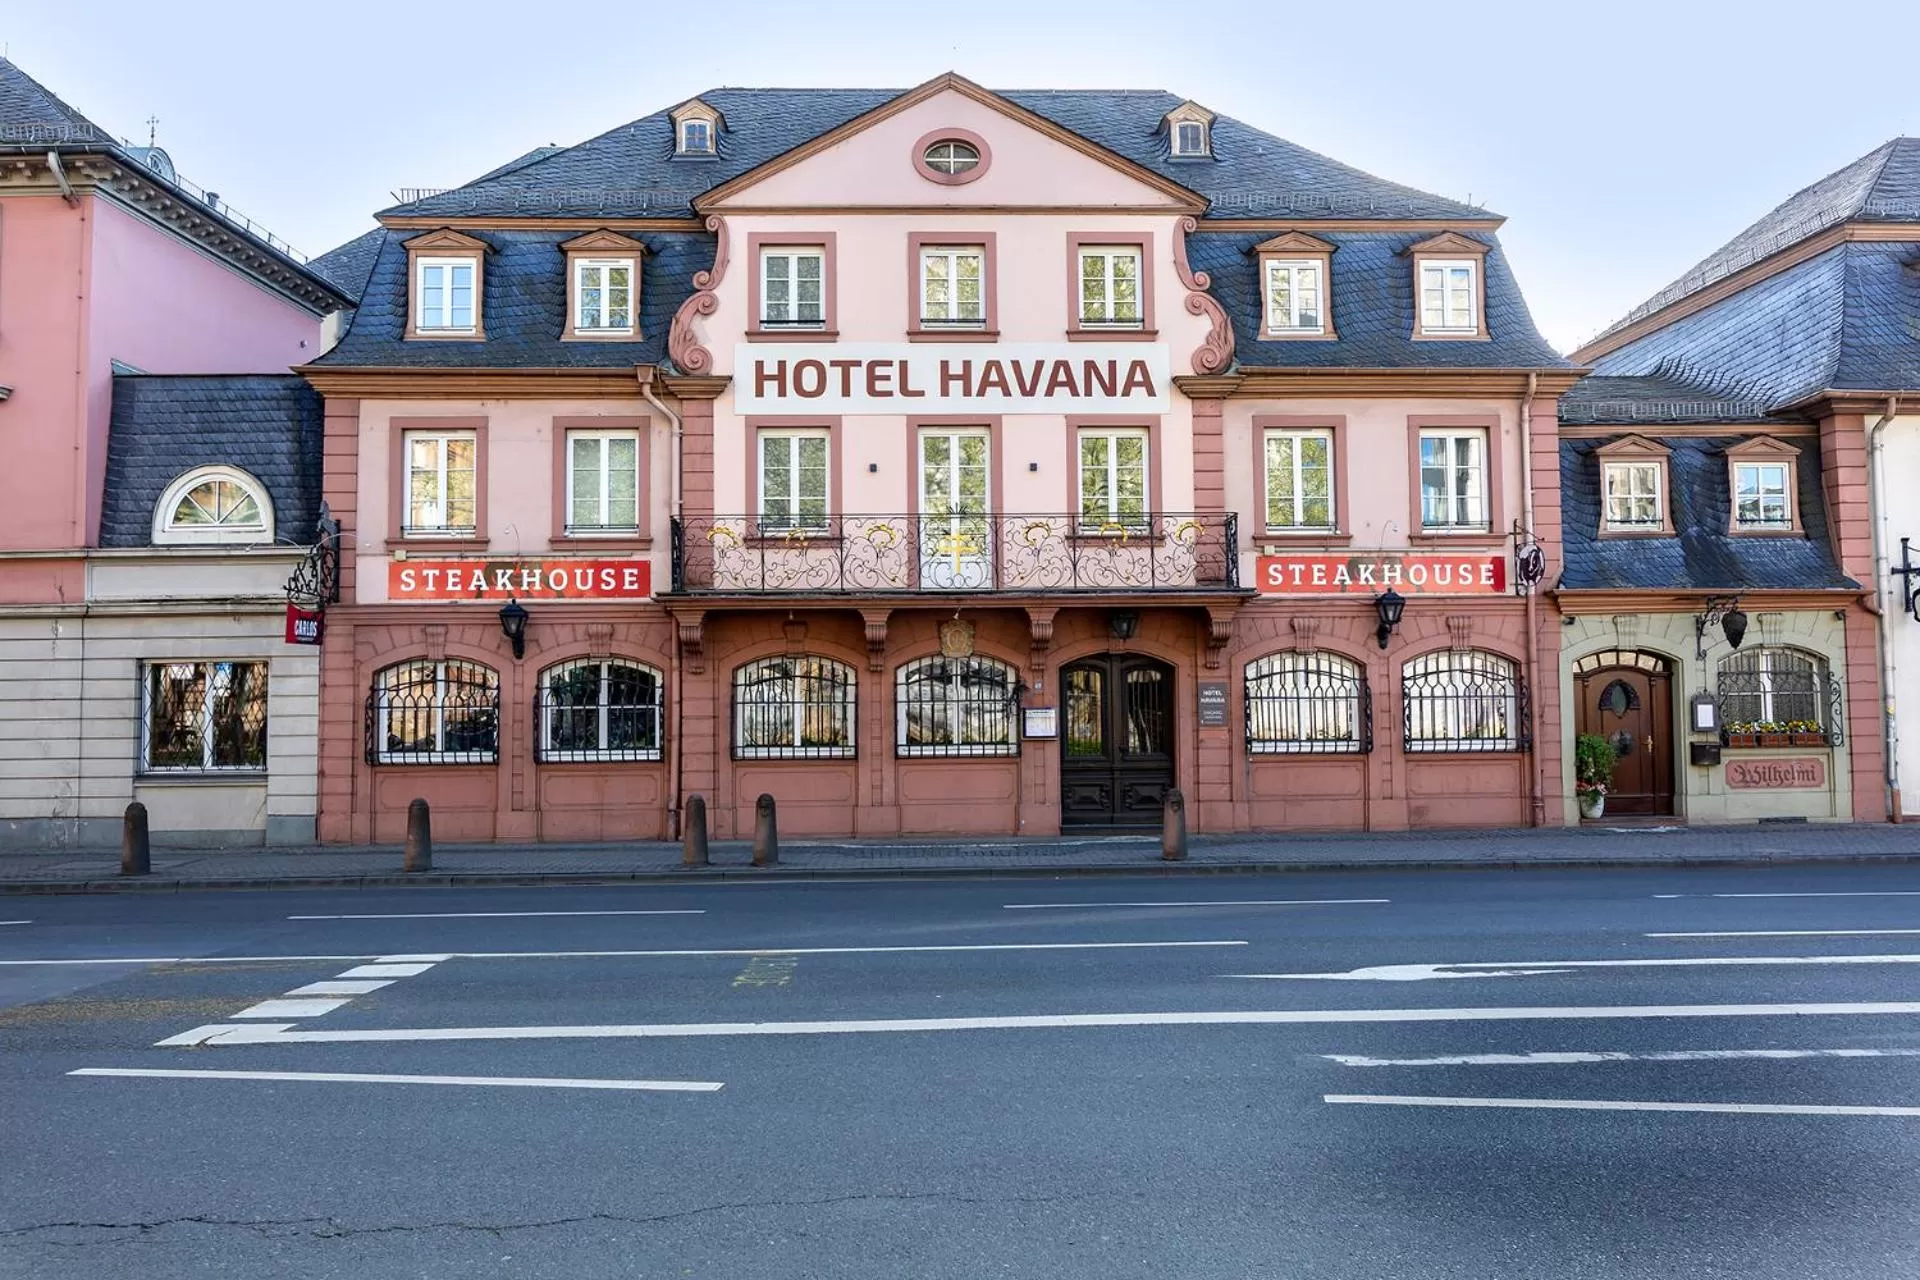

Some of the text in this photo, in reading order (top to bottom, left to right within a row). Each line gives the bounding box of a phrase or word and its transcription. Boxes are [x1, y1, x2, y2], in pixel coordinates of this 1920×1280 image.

[754, 359, 1157, 398] HOTEL HAVANA
[400, 568, 639, 592] STEAKHOUSE
[1268, 563, 1495, 586] STEAKHOUSE
[294, 619, 318, 637] CARLOS
[1731, 763, 1817, 787] Wilhelmi
